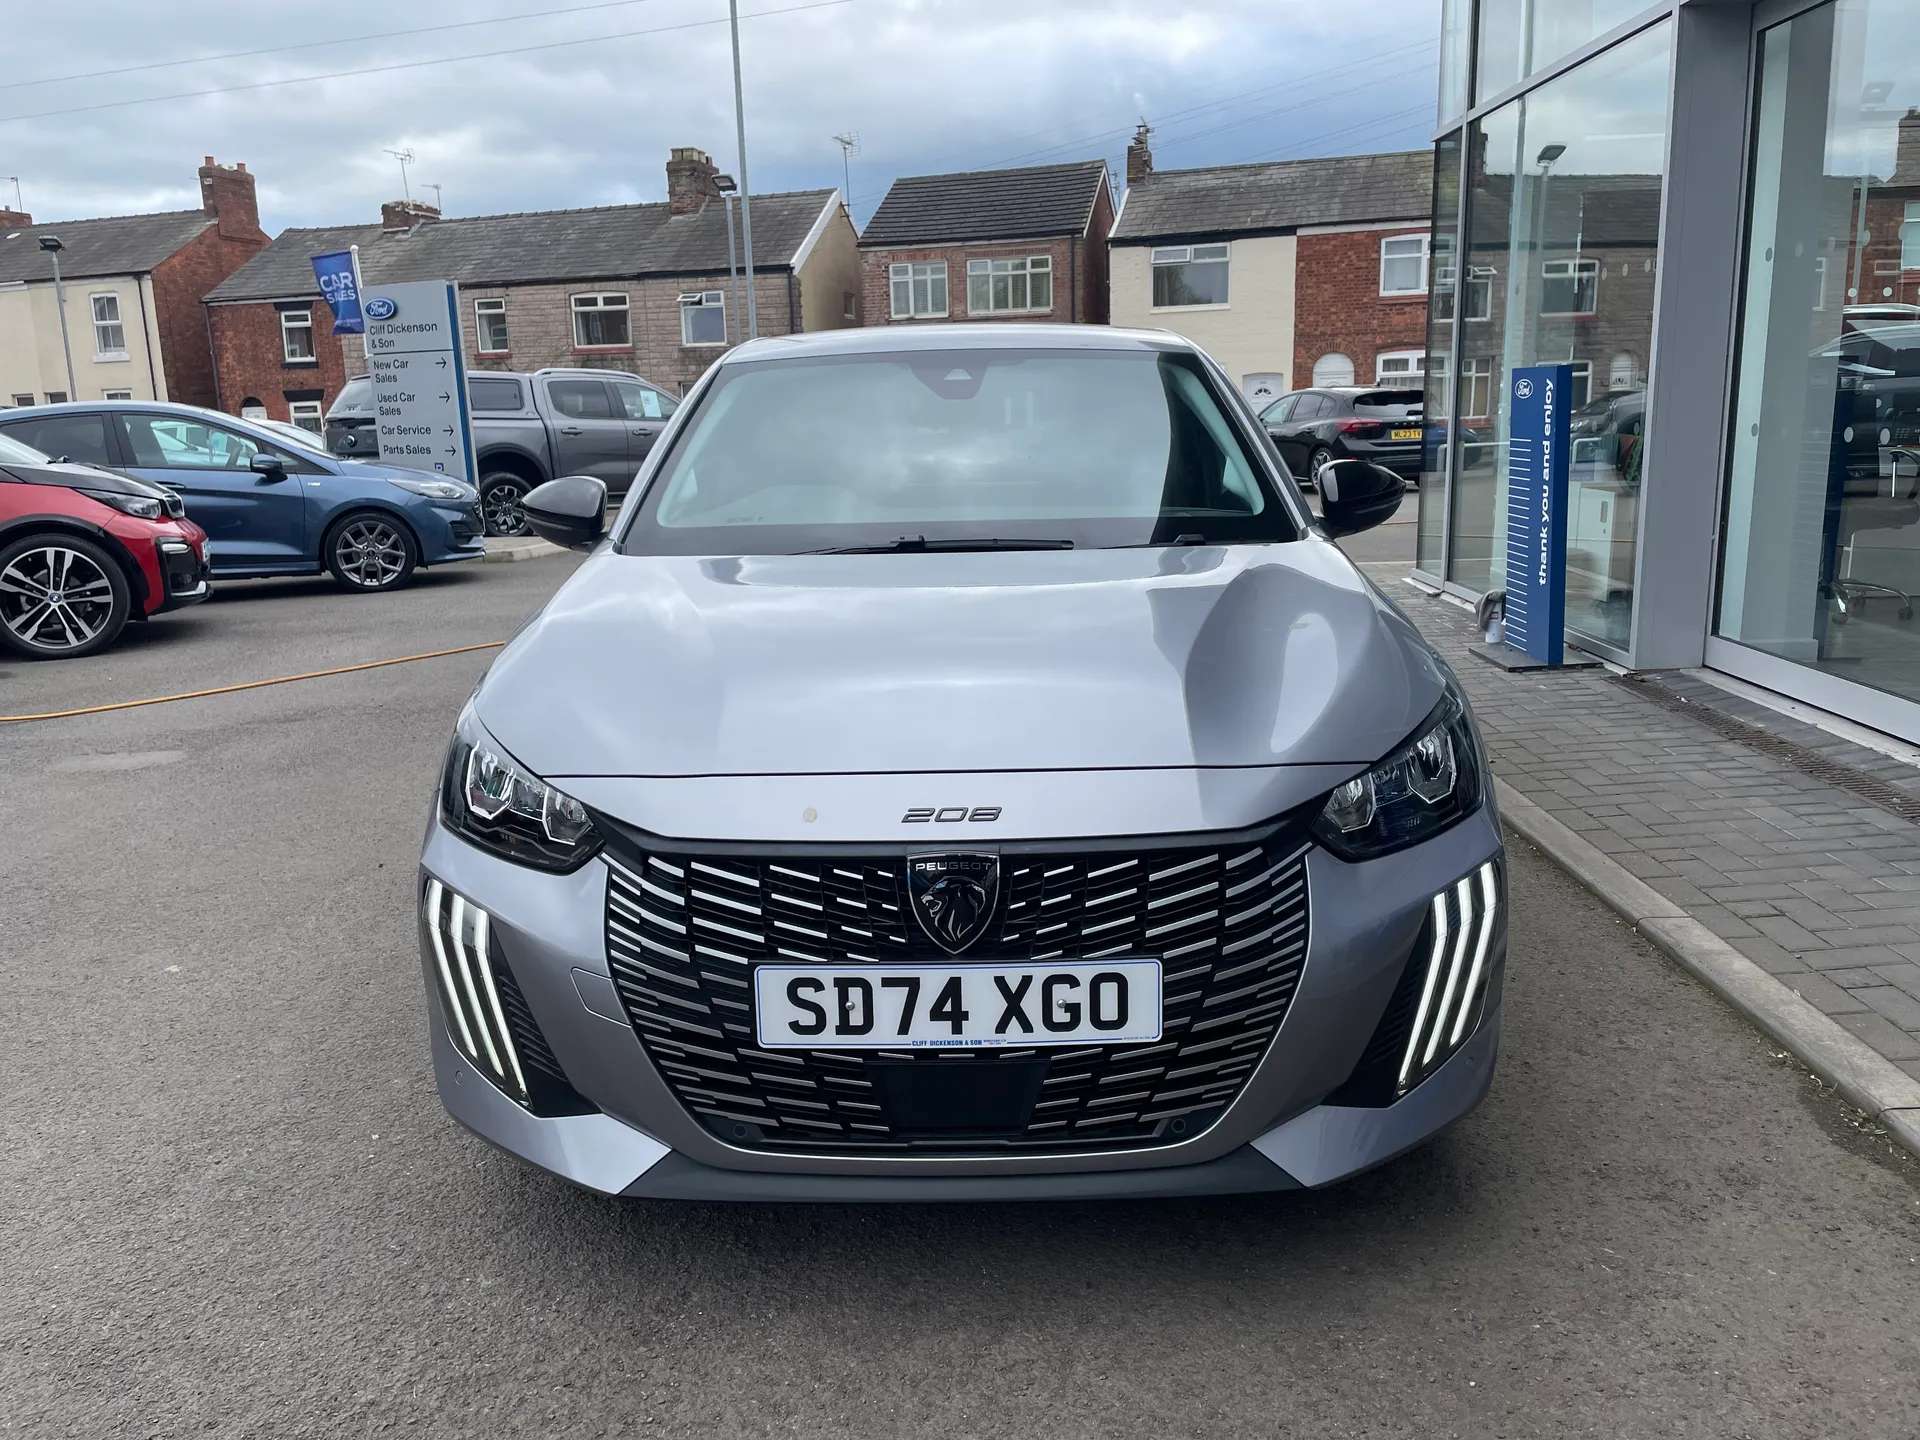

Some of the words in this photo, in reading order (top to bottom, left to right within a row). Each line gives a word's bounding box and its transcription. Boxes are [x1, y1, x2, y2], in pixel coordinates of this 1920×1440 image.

[320, 272, 353, 292] CAR
[370, 324, 385, 336] Cliff
[387, 322, 438, 334] Dickenson
[371, 341, 377, 349] &
[378, 339, 395, 348] Son
[373, 360, 391, 370] New
[393, 359, 409, 369] Car
[375, 373, 398, 383] Sales
[377, 393, 397, 403] Used
[400, 392, 415, 402] Car
[379, 406, 401, 416] Sales
[1543, 379, 1553, 436] enjoy
[381, 425, 395, 435] Car
[397, 424, 431, 435] Service
[383, 445, 404, 455] Parts
[406, 444, 431, 455] Sales
[1542, 440, 1551, 481] and
[1541, 485, 1549, 522] you
[1538, 526, 1548, 586] thank
[901, 806, 1002, 823] 208
[915, 861, 992, 872] PEUGEOT
[786, 976, 969, 1036] SD74
[993, 972, 1129, 1034] XGO
